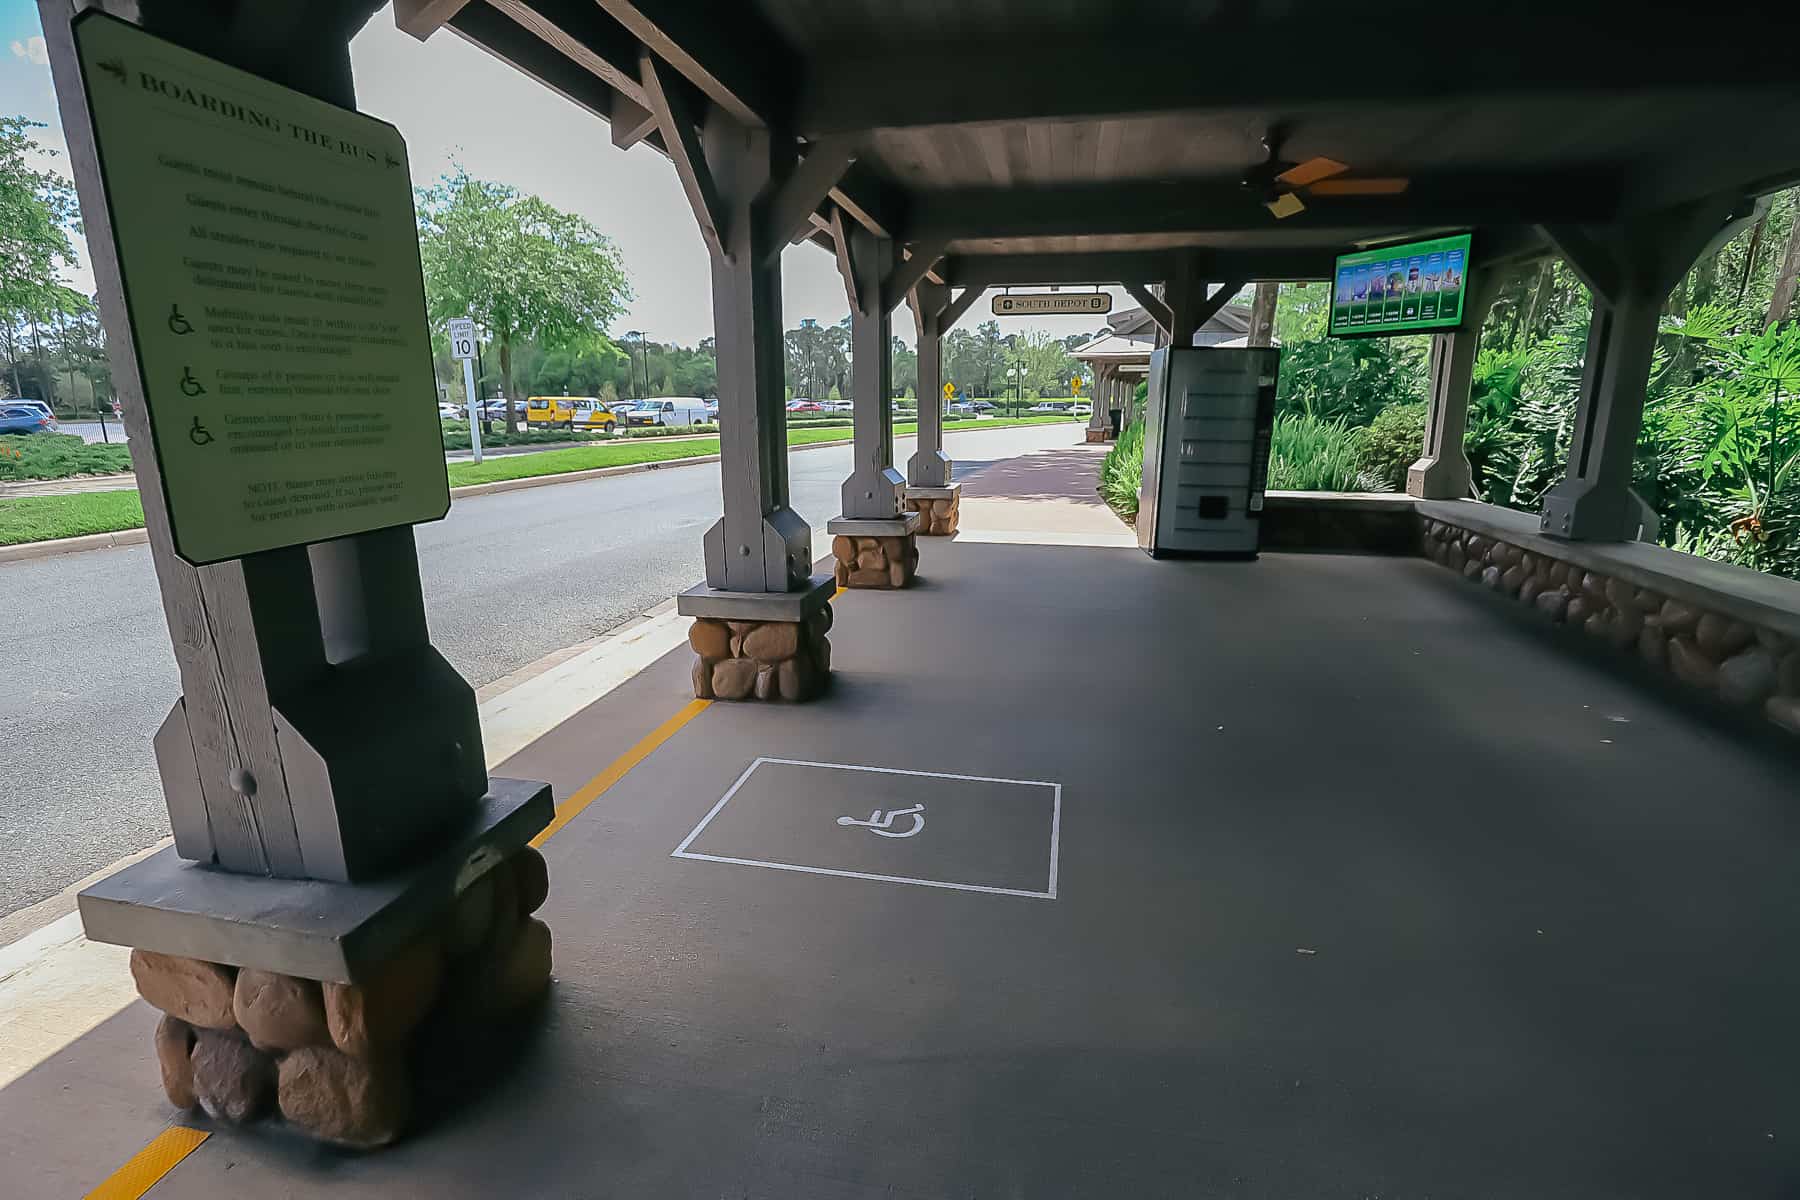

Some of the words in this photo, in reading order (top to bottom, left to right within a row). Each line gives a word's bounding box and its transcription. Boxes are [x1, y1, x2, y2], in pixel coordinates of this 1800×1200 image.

[137, 71, 281, 133] BOARDING
[288, 122, 333, 150] THE
[339, 139, 378, 166] BUS
[1016, 300, 1050, 309] SOUTH
[1054, 299, 1087, 308] DEPOT
[456, 340, 471, 355] 10
